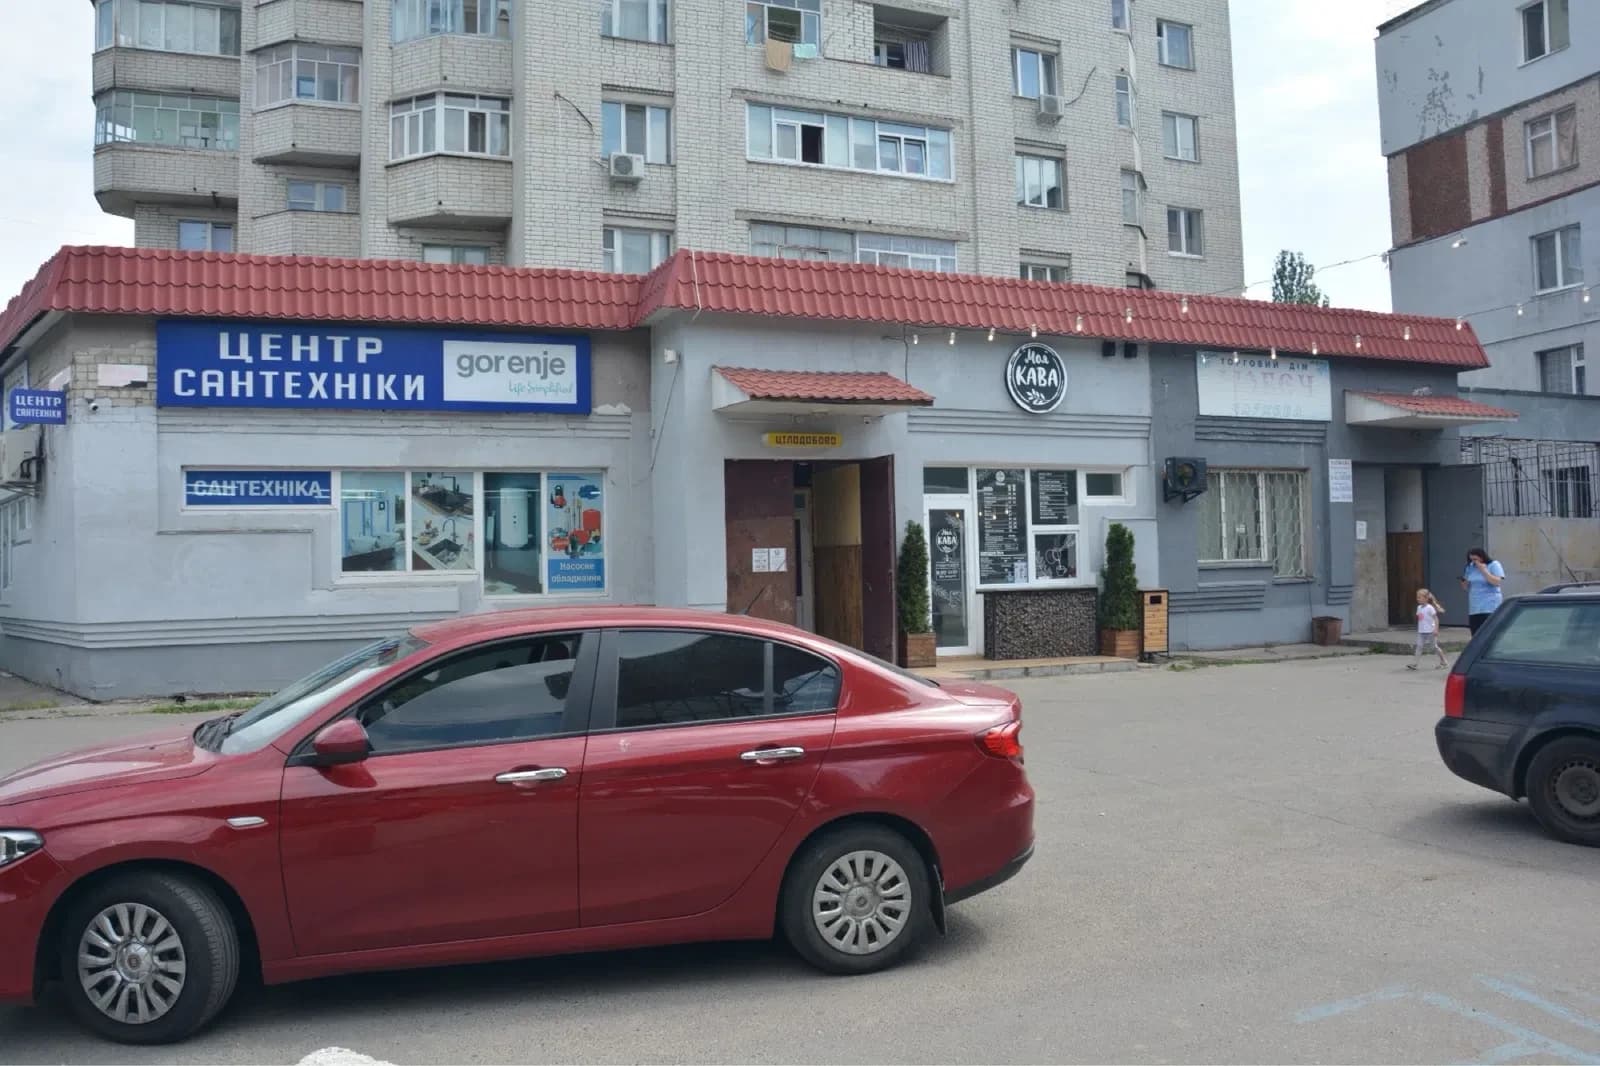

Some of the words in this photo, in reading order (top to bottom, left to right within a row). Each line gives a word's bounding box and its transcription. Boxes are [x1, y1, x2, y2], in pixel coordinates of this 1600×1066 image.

[219, 332, 383, 363] ЦЕНТР
[1024, 348, 1049, 364] Моя
[456, 350, 566, 380] gorenje
[173, 368, 425, 401] САНТЕХНІКИ
[1015, 365, 1058, 387] КАВА
[15, 395, 62, 407] ЦЕНТР
[15, 408, 62, 418] САНТЕХНІКИ
[193, 480, 322, 497] САНТЕХНІКА
